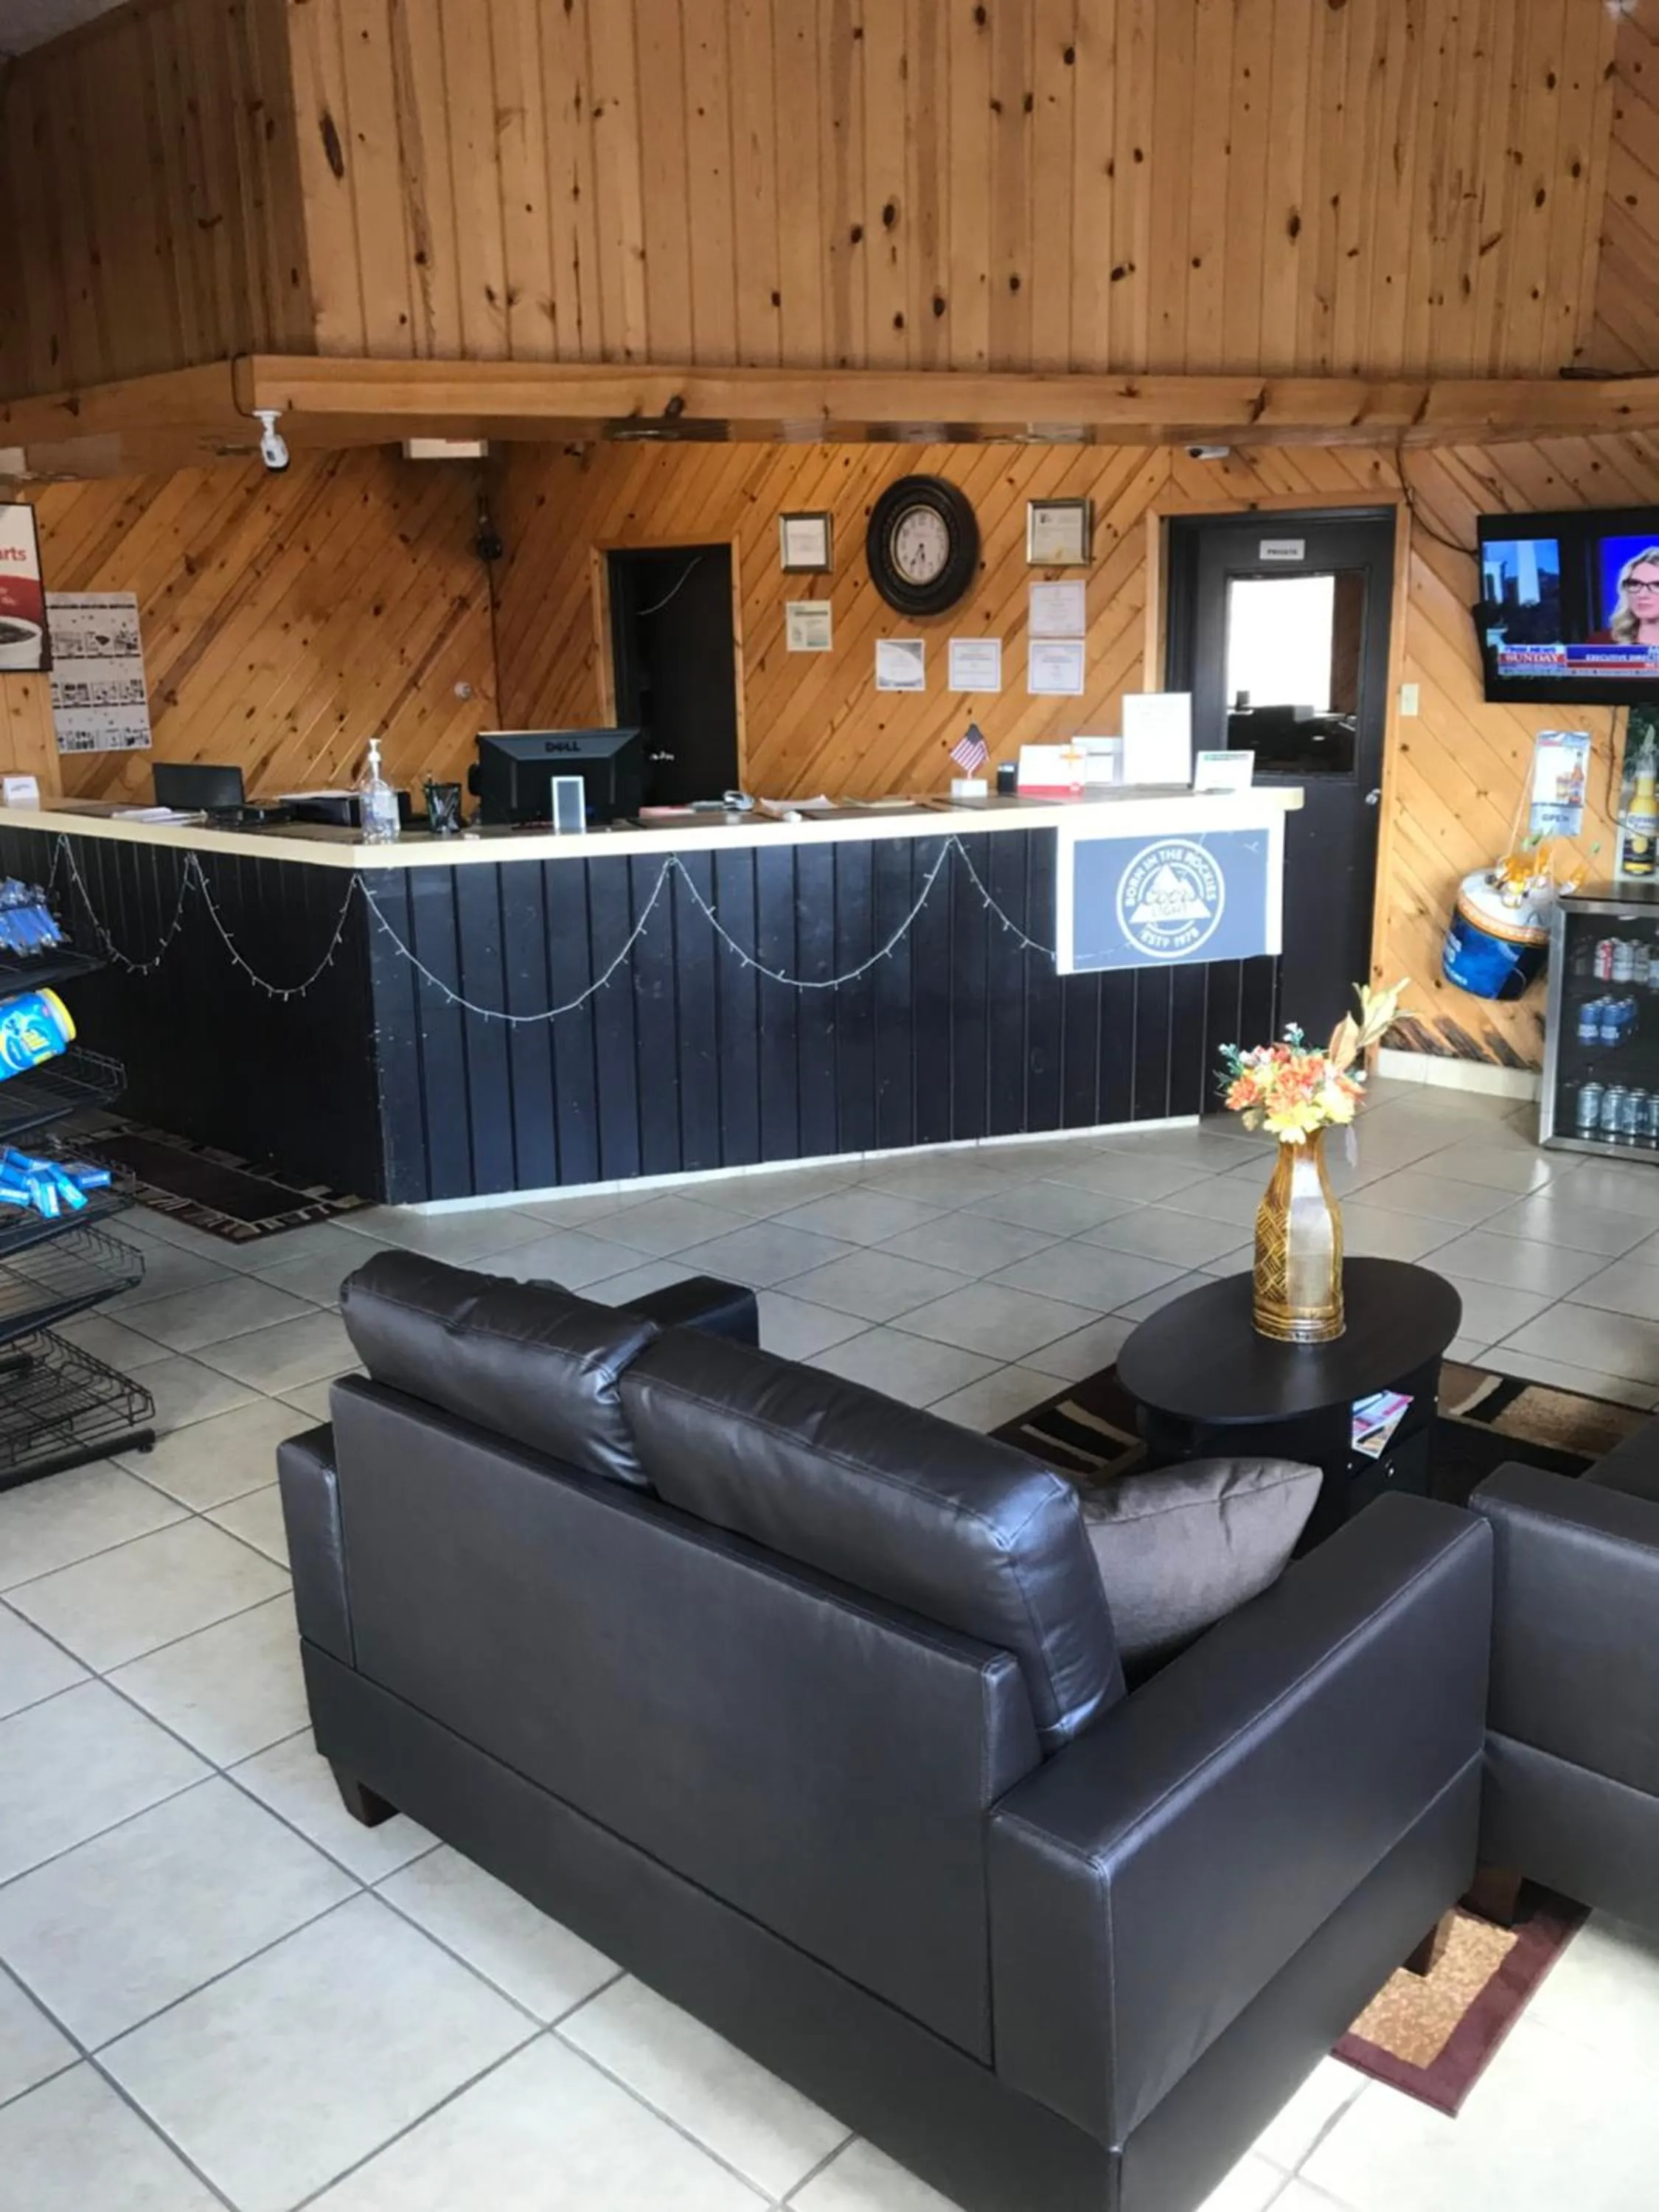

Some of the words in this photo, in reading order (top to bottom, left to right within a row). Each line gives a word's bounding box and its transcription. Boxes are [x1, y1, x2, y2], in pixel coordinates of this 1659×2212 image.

[1506, 653, 1559, 662] SUNDAY
[545, 740, 582, 753] DELL
[1125, 868, 1146, 907] BORN
[1142, 854, 1159, 872] IN
[1158, 848, 1184, 863] THE
[1184, 850, 1217, 902] ROCKIES
